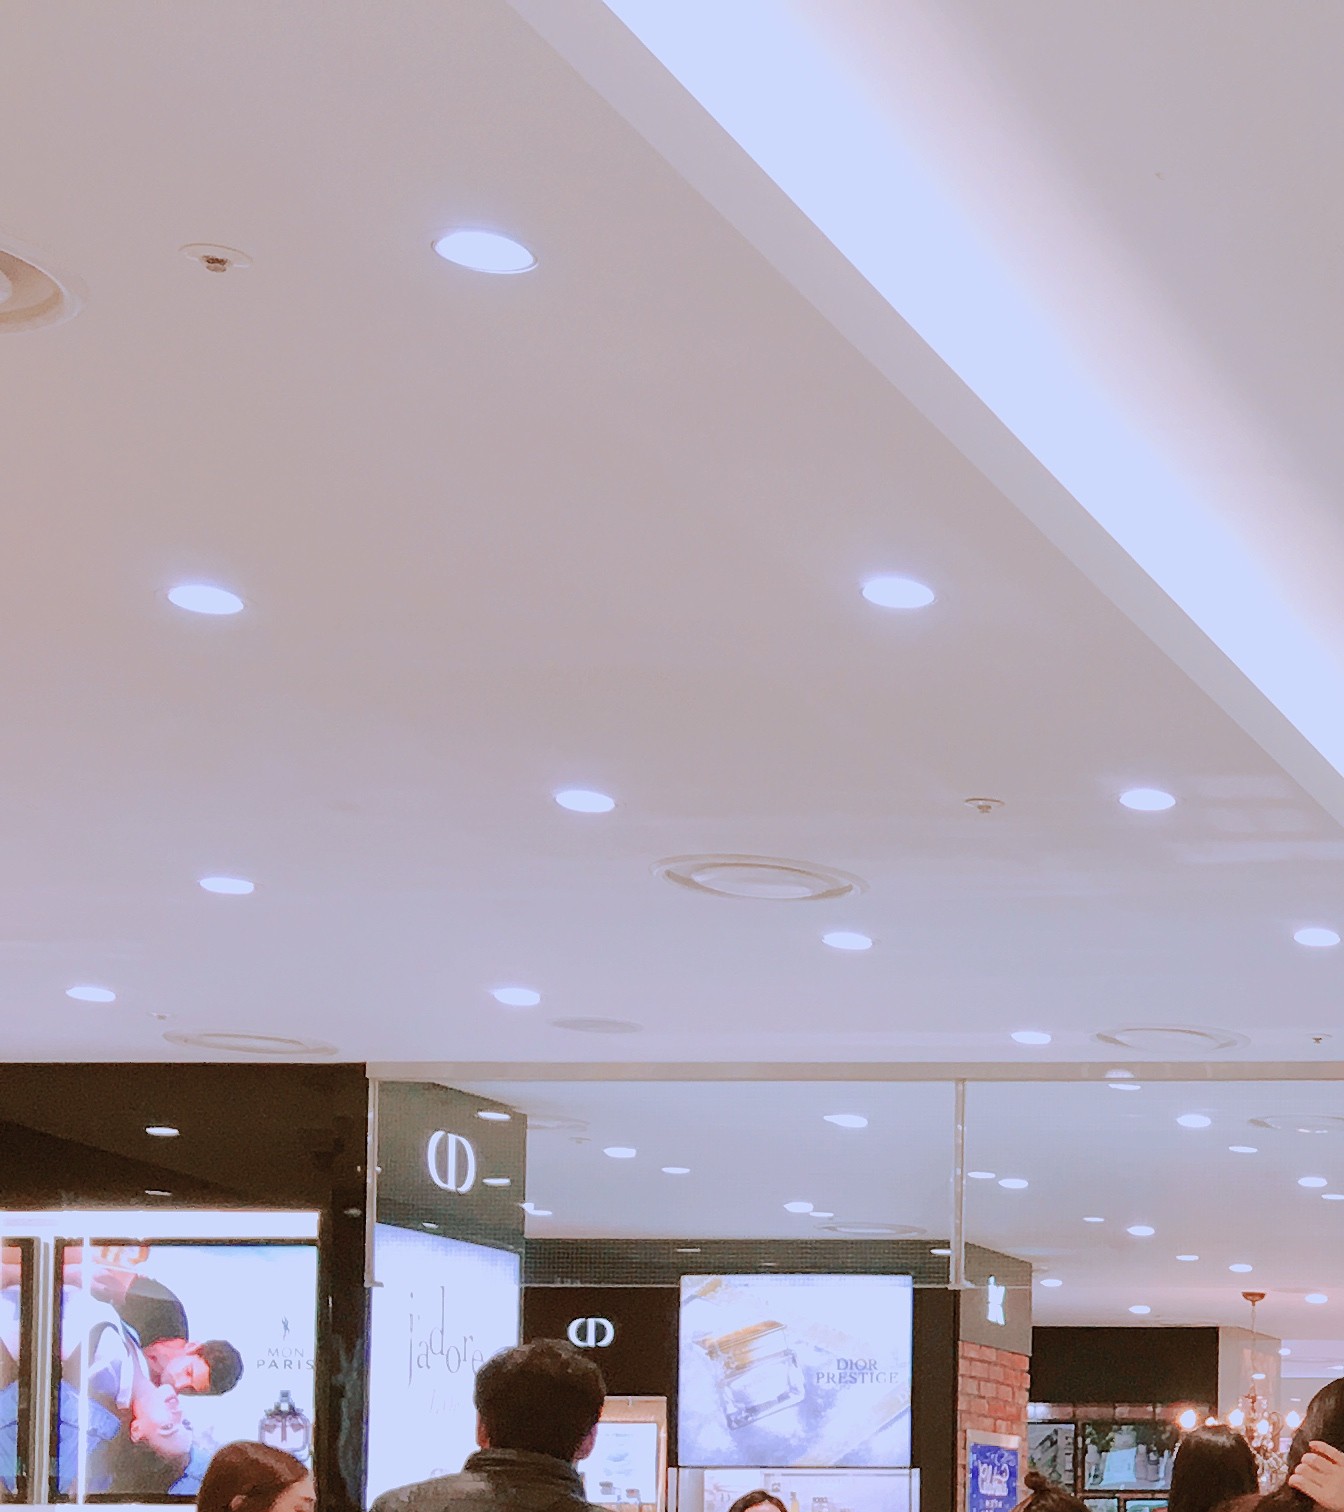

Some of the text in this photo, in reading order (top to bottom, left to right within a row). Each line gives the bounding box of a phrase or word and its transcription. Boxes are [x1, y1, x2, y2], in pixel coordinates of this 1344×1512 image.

[267, 1347, 304, 1358] MON
[256, 1359, 315, 1370] PARIS
[836, 1358, 878, 1371] DIOR
[815, 1371, 899, 1385] PRESTIGE
